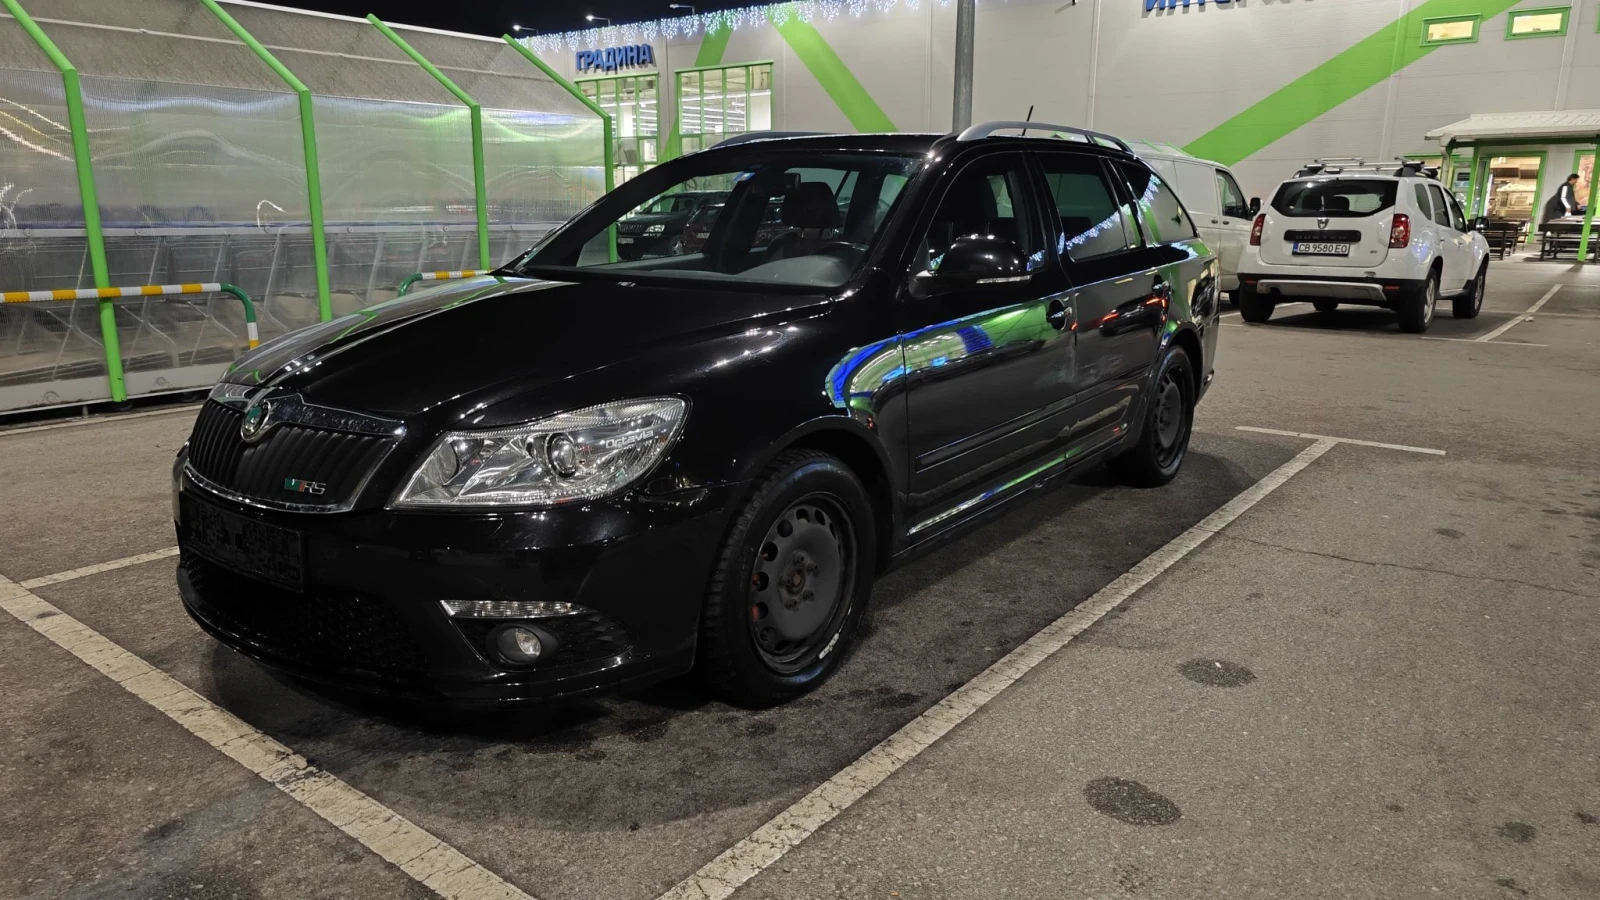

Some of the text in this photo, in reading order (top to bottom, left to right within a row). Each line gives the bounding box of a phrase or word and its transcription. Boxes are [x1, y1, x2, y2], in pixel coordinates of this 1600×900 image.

[576, 43, 654, 72] ГРАДИНА
[1298, 243, 1310, 252] CB
[1312, 244, 1334, 252] 9580
[605, 430, 654, 449] Octavia
